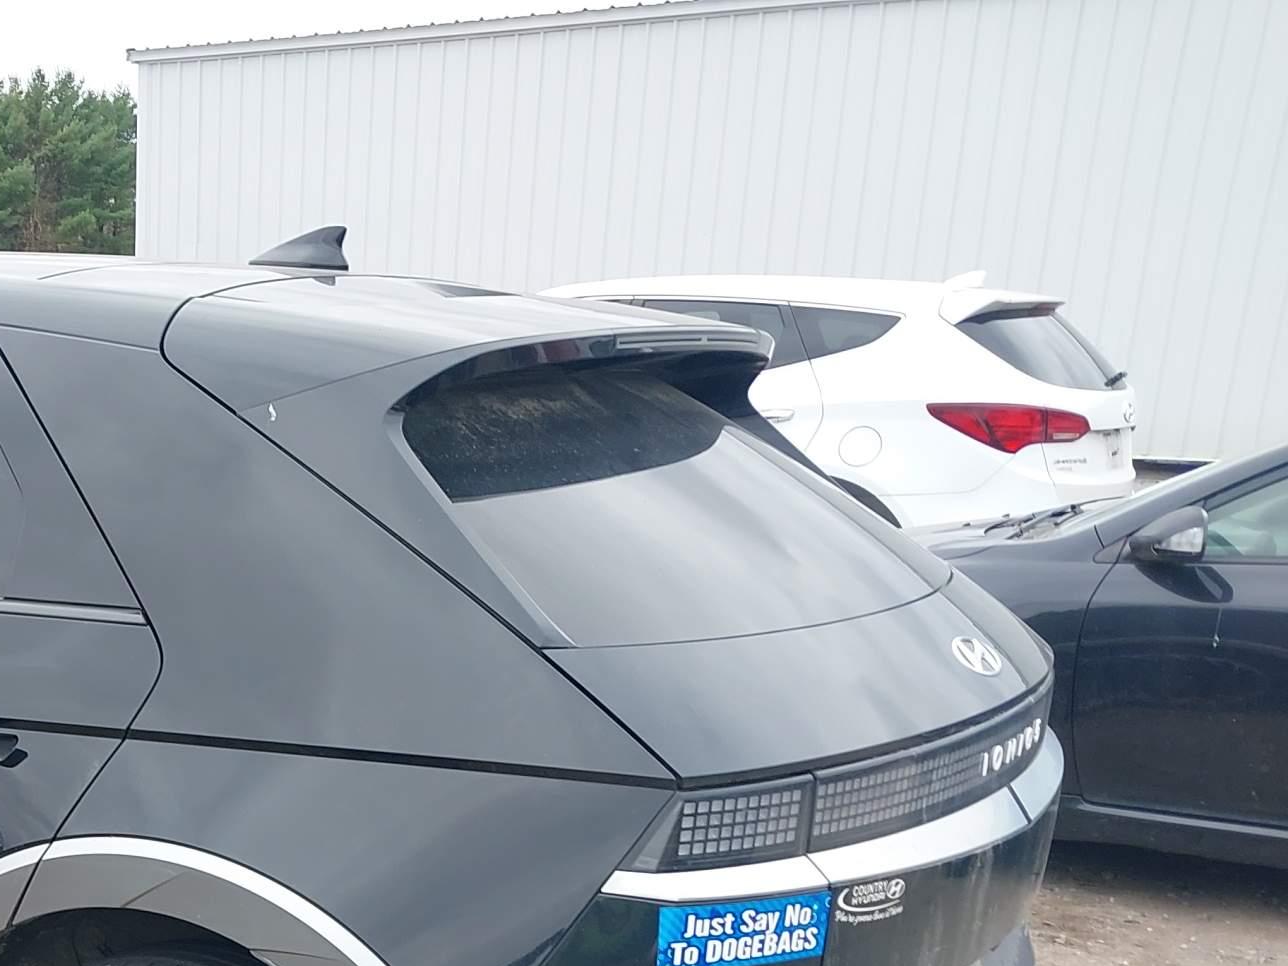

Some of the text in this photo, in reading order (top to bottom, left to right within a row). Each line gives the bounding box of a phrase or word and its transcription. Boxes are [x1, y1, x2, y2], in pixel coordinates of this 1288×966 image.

[683, 913, 735, 939] Just
[739, 909, 780, 936] Say
[784, 903, 812, 928] No
[670, 927, 819, 966] To DOGEBAGS
